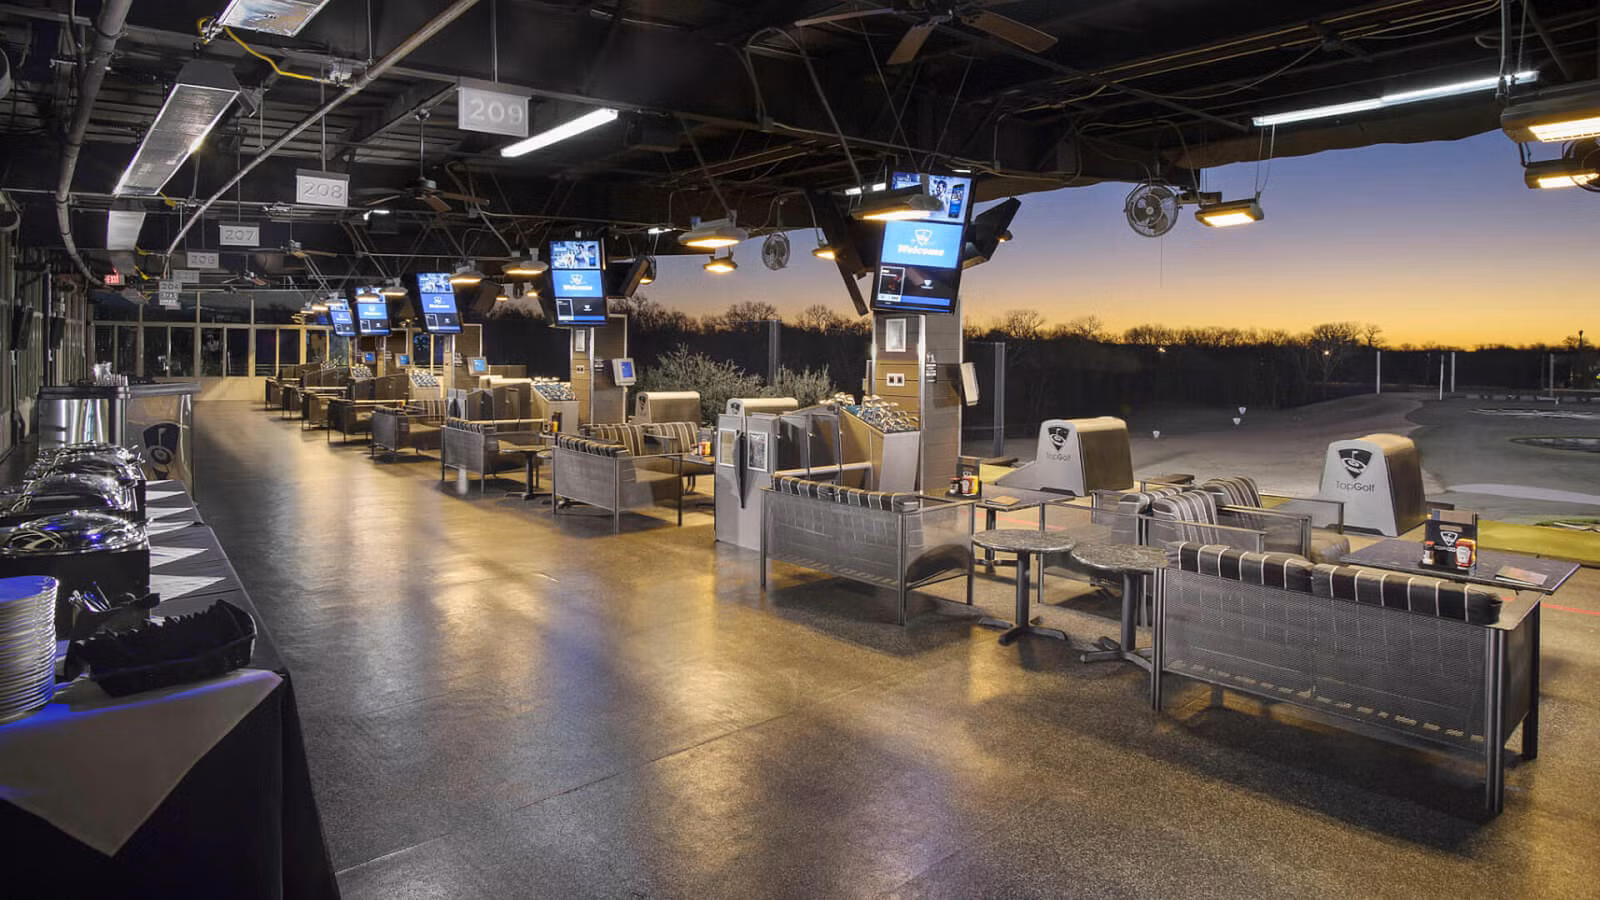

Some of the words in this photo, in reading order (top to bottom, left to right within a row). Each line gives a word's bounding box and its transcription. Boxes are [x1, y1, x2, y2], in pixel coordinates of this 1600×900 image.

[469, 98, 523, 125] 209
[303, 181, 343, 199] 208
[225, 229, 257, 242] 207
[1336, 480, 1375, 492] TopGolf
